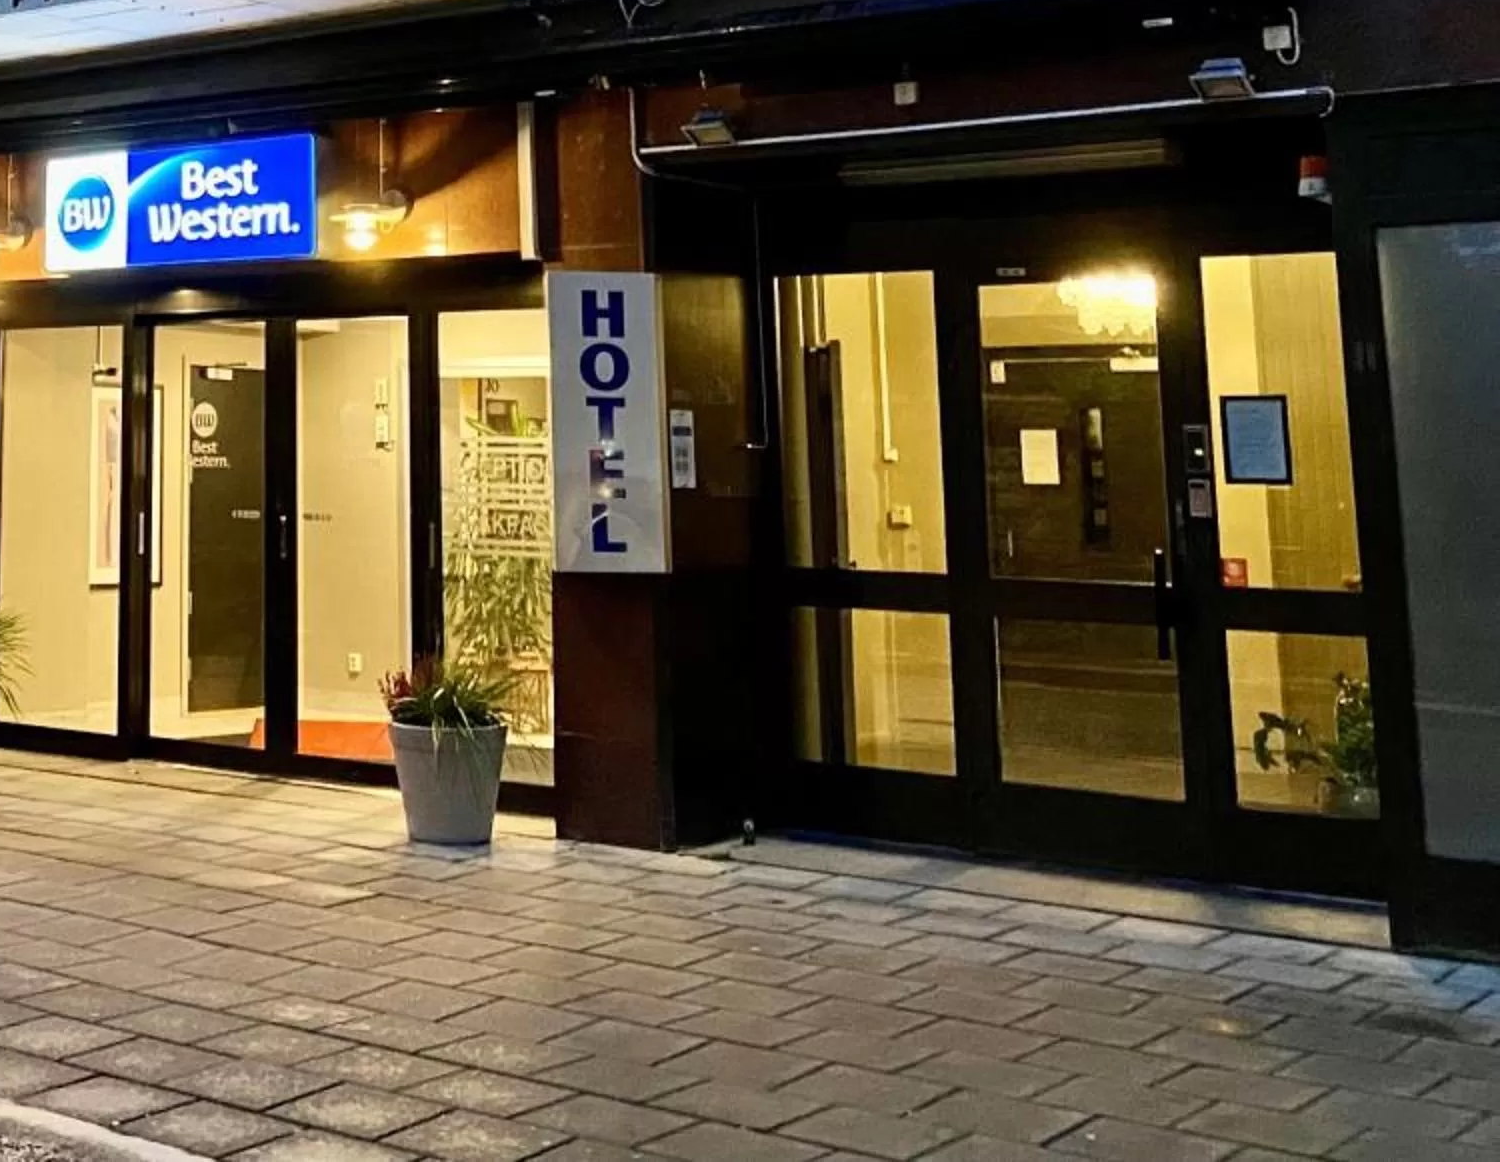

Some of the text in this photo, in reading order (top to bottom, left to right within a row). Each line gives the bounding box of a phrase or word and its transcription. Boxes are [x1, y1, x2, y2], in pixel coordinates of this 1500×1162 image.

[180, 159, 259, 201] Best
[62, 196, 111, 233] BW
[579, 289, 630, 554] HOTEL
[192, 439, 218, 455] Best
